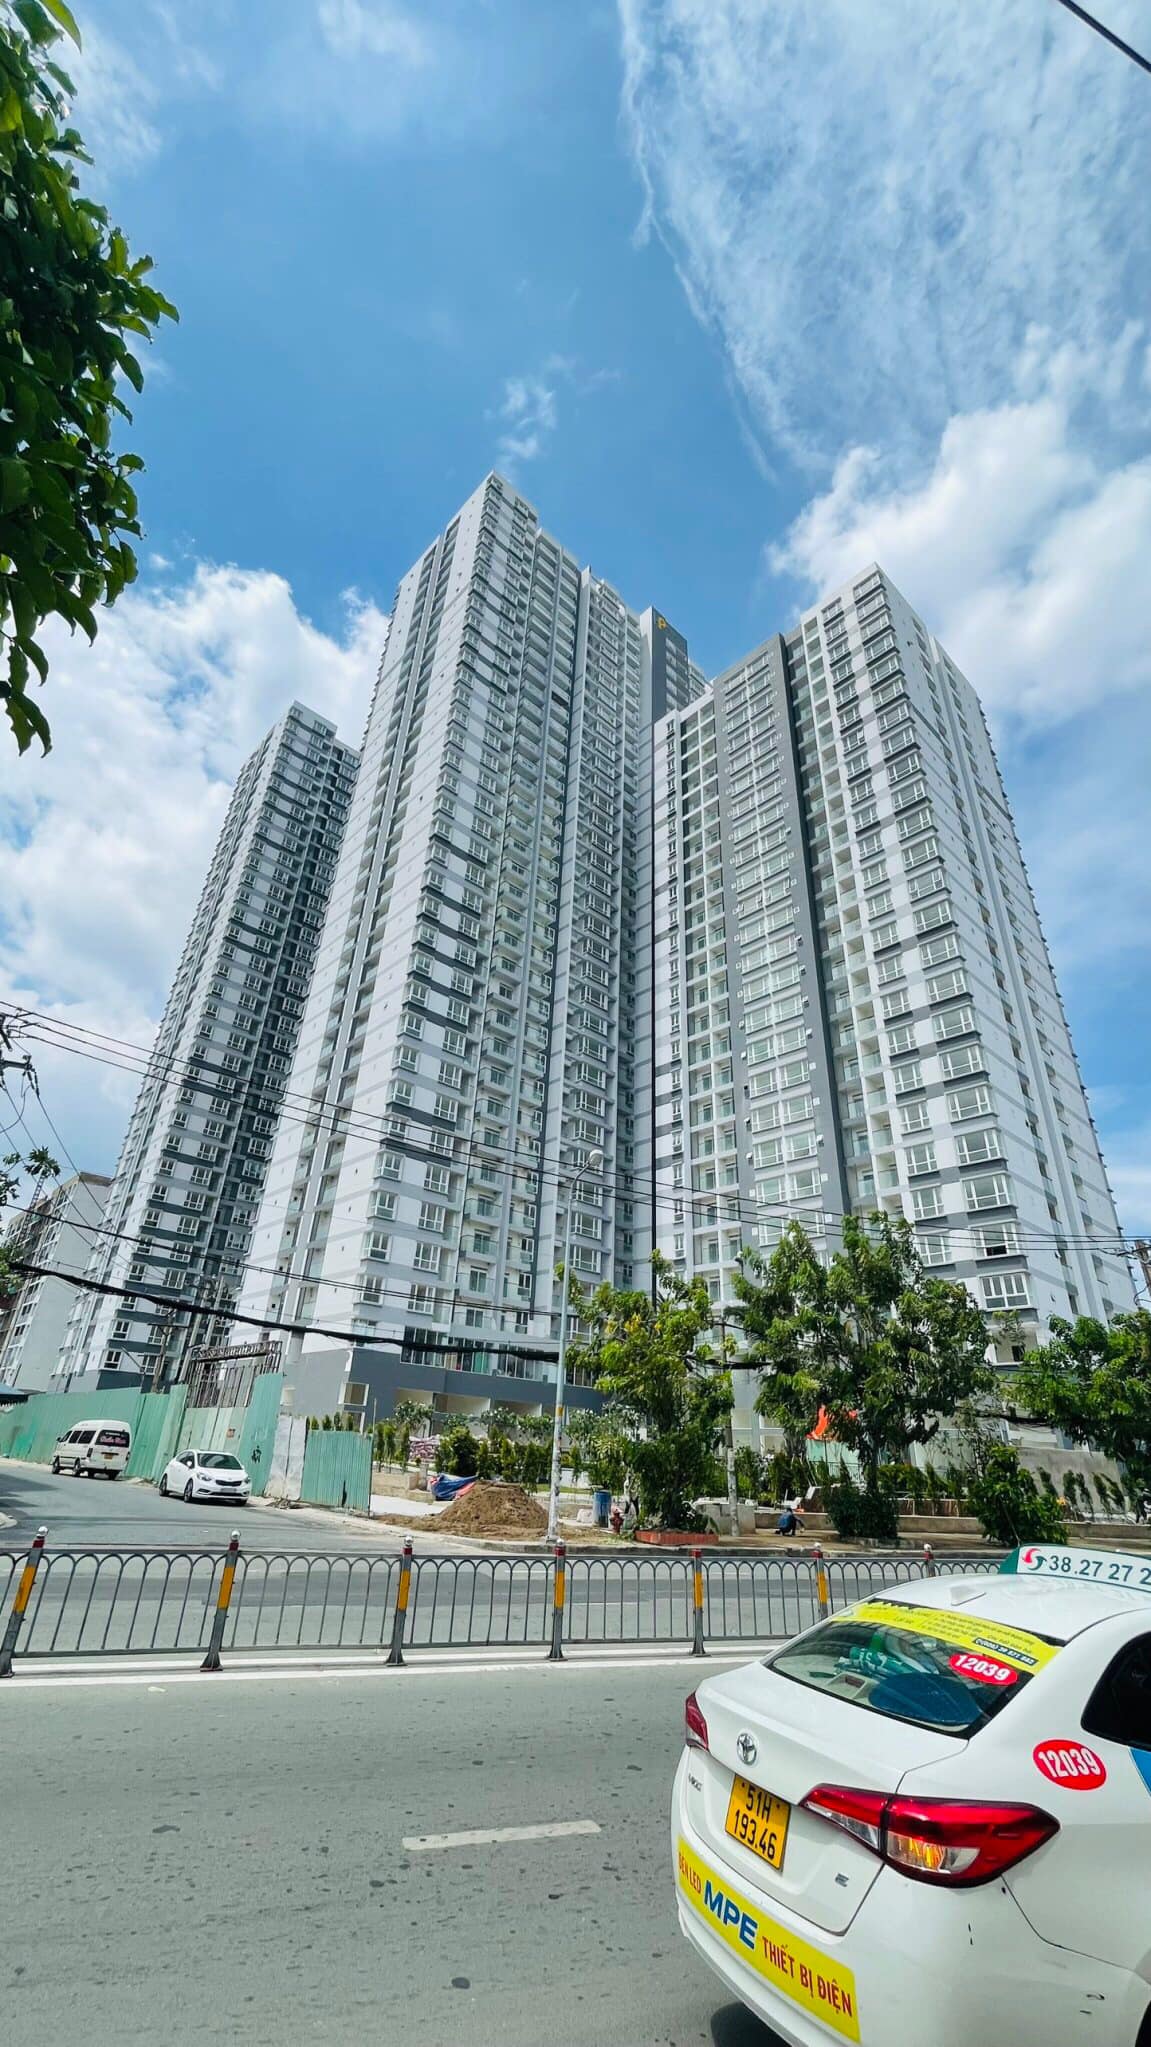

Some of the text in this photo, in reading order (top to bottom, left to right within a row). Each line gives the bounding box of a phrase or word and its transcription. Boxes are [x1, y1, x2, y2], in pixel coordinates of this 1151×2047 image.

[1108, 1563, 1133, 1582] 27
[955, 1655, 1010, 1681] 12039
[1038, 1747, 1101, 1778] 12039
[746, 1785, 772, 1823] 51H
[734, 1809, 777, 1860] 193.46
[689, 1866, 702, 1894] LED
[704, 1879, 758, 1950] MPE
[762, 1936, 795, 1978] THIẾT
[799, 1962, 814, 1998] BỊ
[817, 1974, 853, 2018] ĐIỆN
